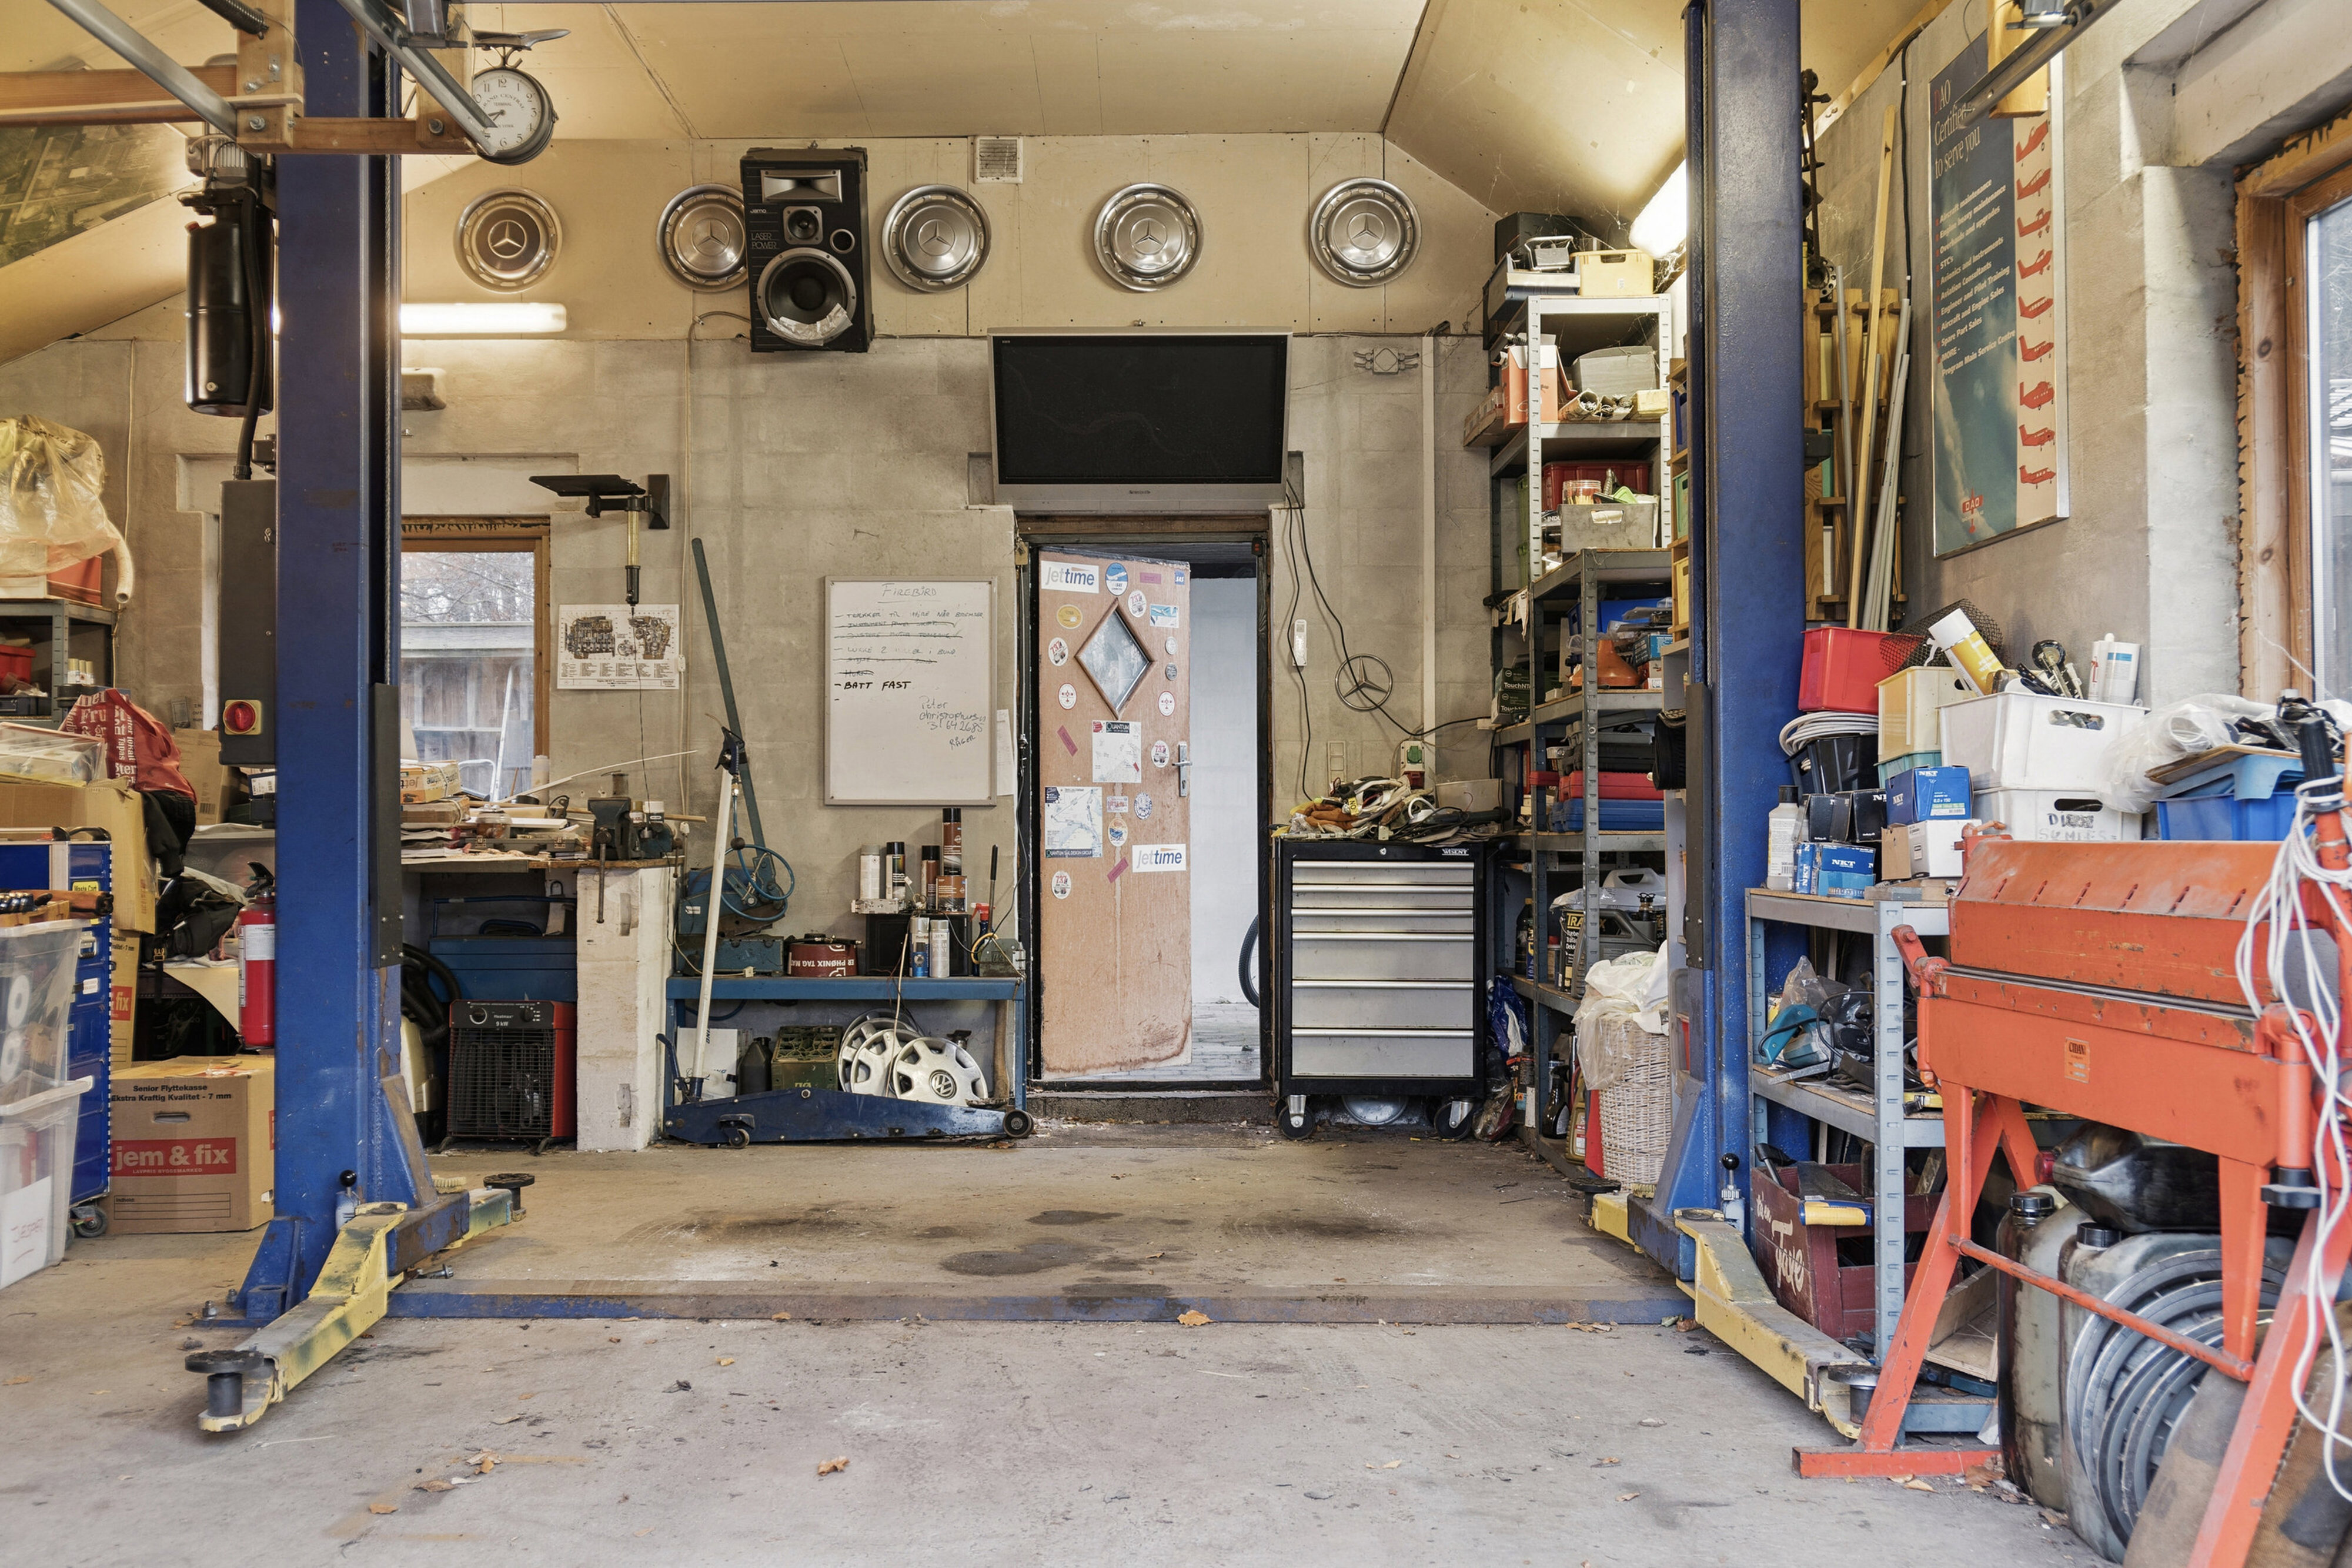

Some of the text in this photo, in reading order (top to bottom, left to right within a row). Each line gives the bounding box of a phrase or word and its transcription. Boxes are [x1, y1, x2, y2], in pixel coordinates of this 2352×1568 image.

[497, 78, 507, 88] 12
[500, 93, 525, 109] CENTRAL
[1934, 79, 1951, 115] DAO
[1935, 125, 1981, 179] to serve you
[1939, 184, 2007, 239] Engine heavy maintenance
[1940, 179, 1993, 224] Aircraft maintenance
[751, 232, 772, 240] LASER
[1939, 205, 2000, 255] Overhauls and upgrades
[751, 241, 777, 249] POWER
[1940, 236, 2004, 285] Avionics and Instruments
[1940, 260, 1993, 300] Aviation Consultants
[1940, 265, 2011, 316] Engineer and Pilot Training
[1941, 285, 2005, 332] Aircraft and Engine Sales
[1941, 316, 1983, 347] Spare Part Sales
[1941, 329, 2016, 377] Program Main Service Centre
[1941, 346, 1957, 362] MORE
[1965, 497, 1980, 511] DAO
[844, 680, 912, 691] BATT FAST
[1802, 864, 1811, 887] NKT
[1831, 859, 1856, 867] NKT
[817, 959, 847, 968] PHØNIX
[115, 991, 129, 1012] fix
[161, 1085, 208, 1093] Flyttekasse
[114, 1144, 229, 1171] jem & fix
